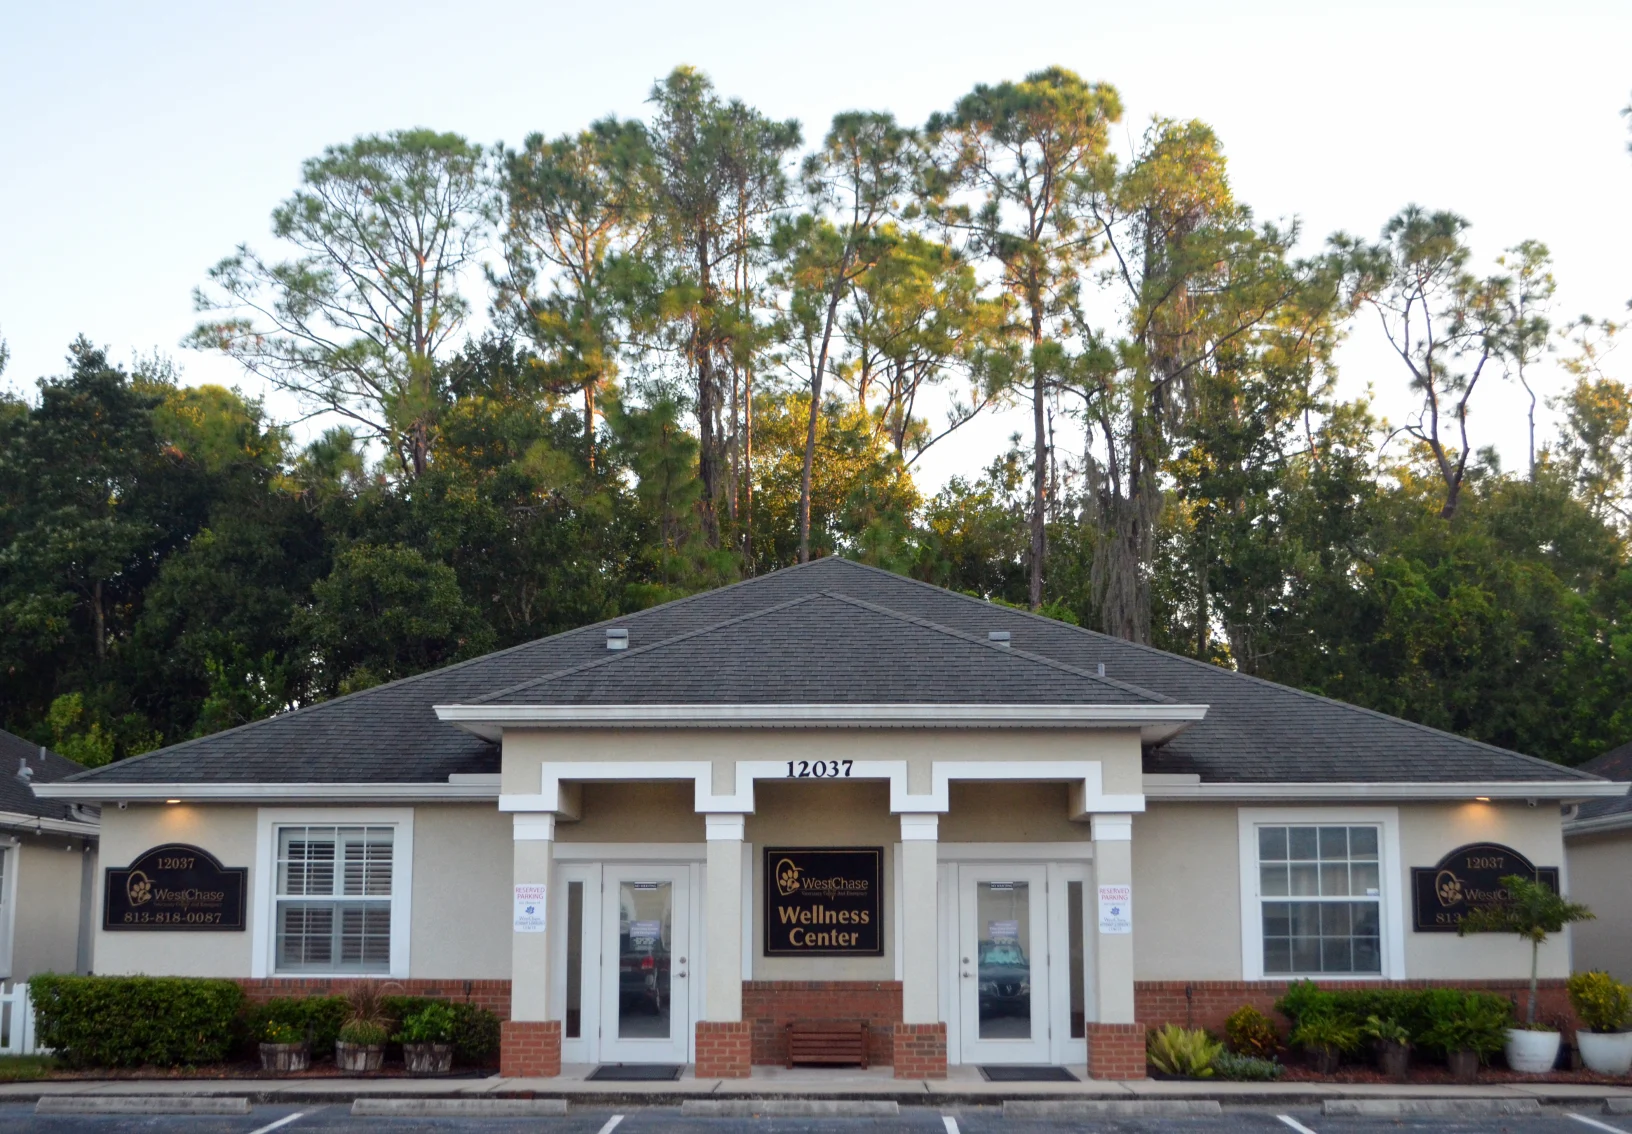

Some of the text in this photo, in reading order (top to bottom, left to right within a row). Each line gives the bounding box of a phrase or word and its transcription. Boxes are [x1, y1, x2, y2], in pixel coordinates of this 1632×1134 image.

[786, 759, 854, 778] 12037
[157, 857, 196, 870] 12037
[1466, 857, 1504, 869] 12037
[801, 876, 869, 890] WestChase
[153, 888, 225, 901] WestChase
[124, 911, 223, 924] 813-818-0087
[778, 904, 870, 925] Wellness
[788, 927, 859, 946] Center
